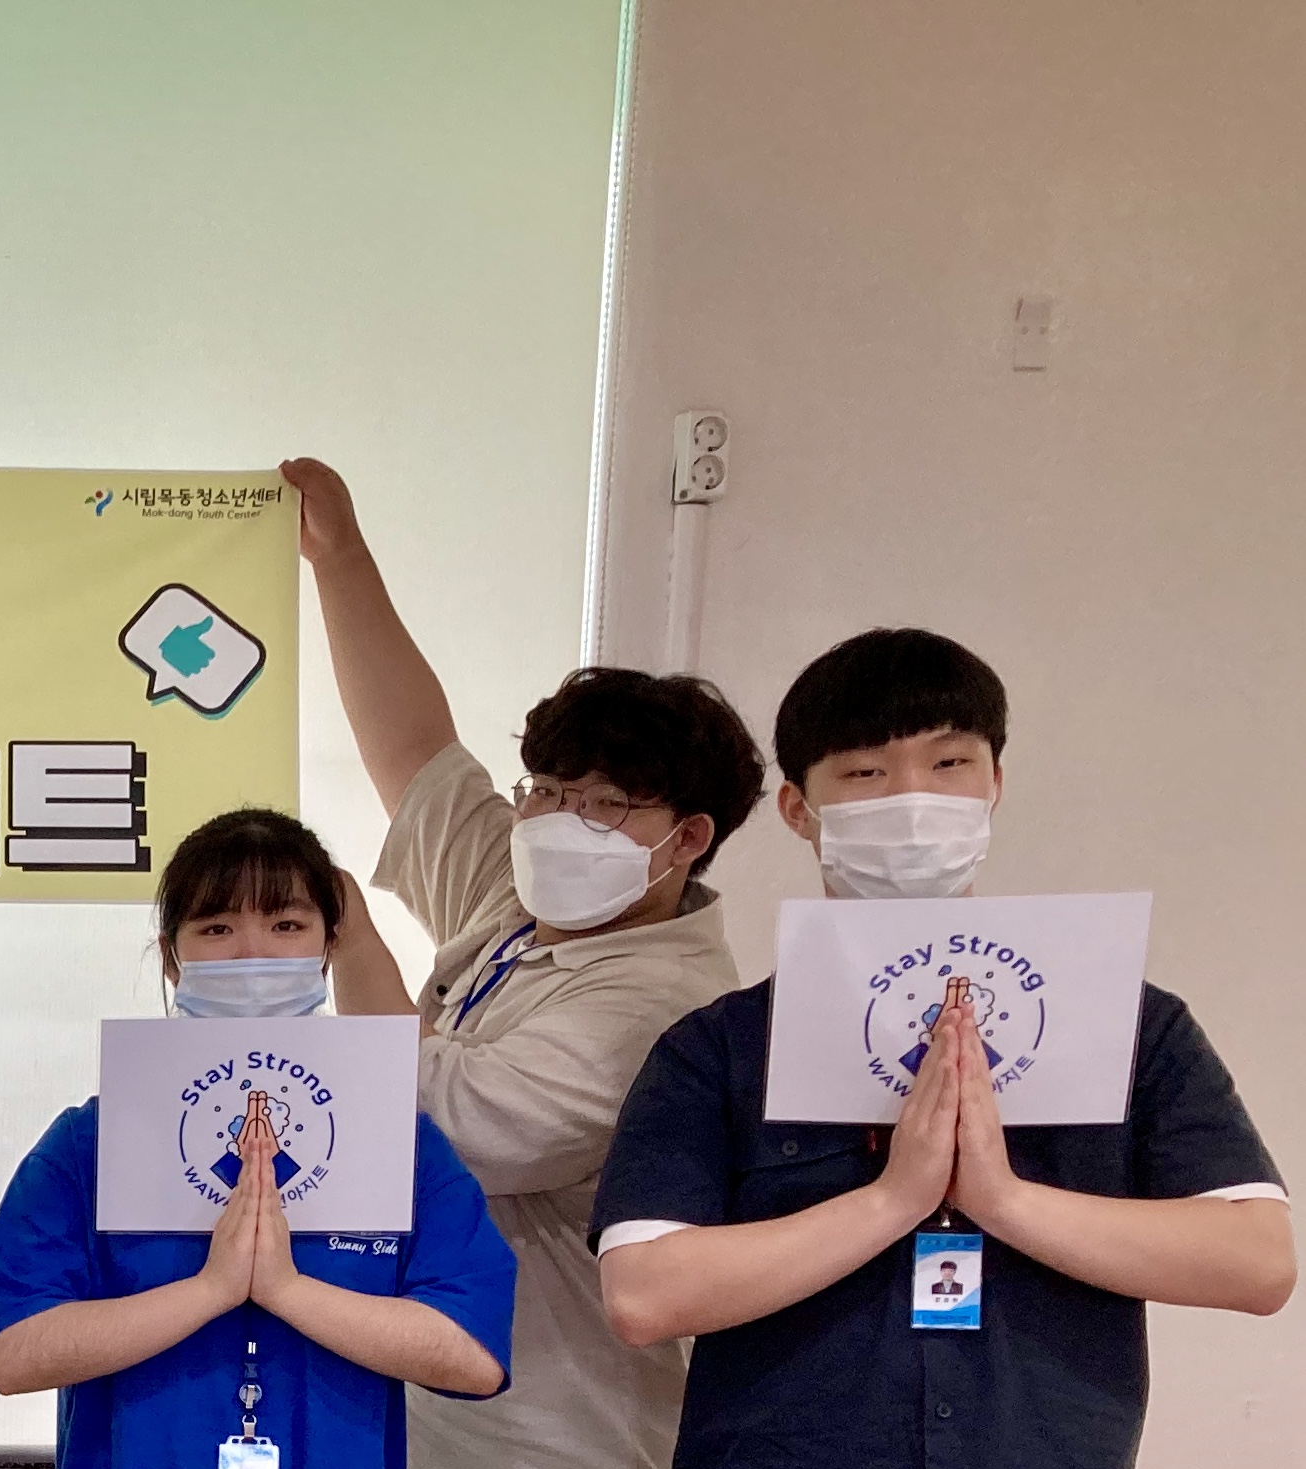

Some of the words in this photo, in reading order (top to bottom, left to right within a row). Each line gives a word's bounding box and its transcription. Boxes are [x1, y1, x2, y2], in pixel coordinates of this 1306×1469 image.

[122, 486, 282, 508] 시립목동청소년센터
[869, 943, 934, 995] Stay
[949, 934, 1046, 994] Strong
[181, 1059, 234, 1107] Stay
[247, 1051, 333, 1107] Strong
[329, 1237, 366, 1255] Sunny
